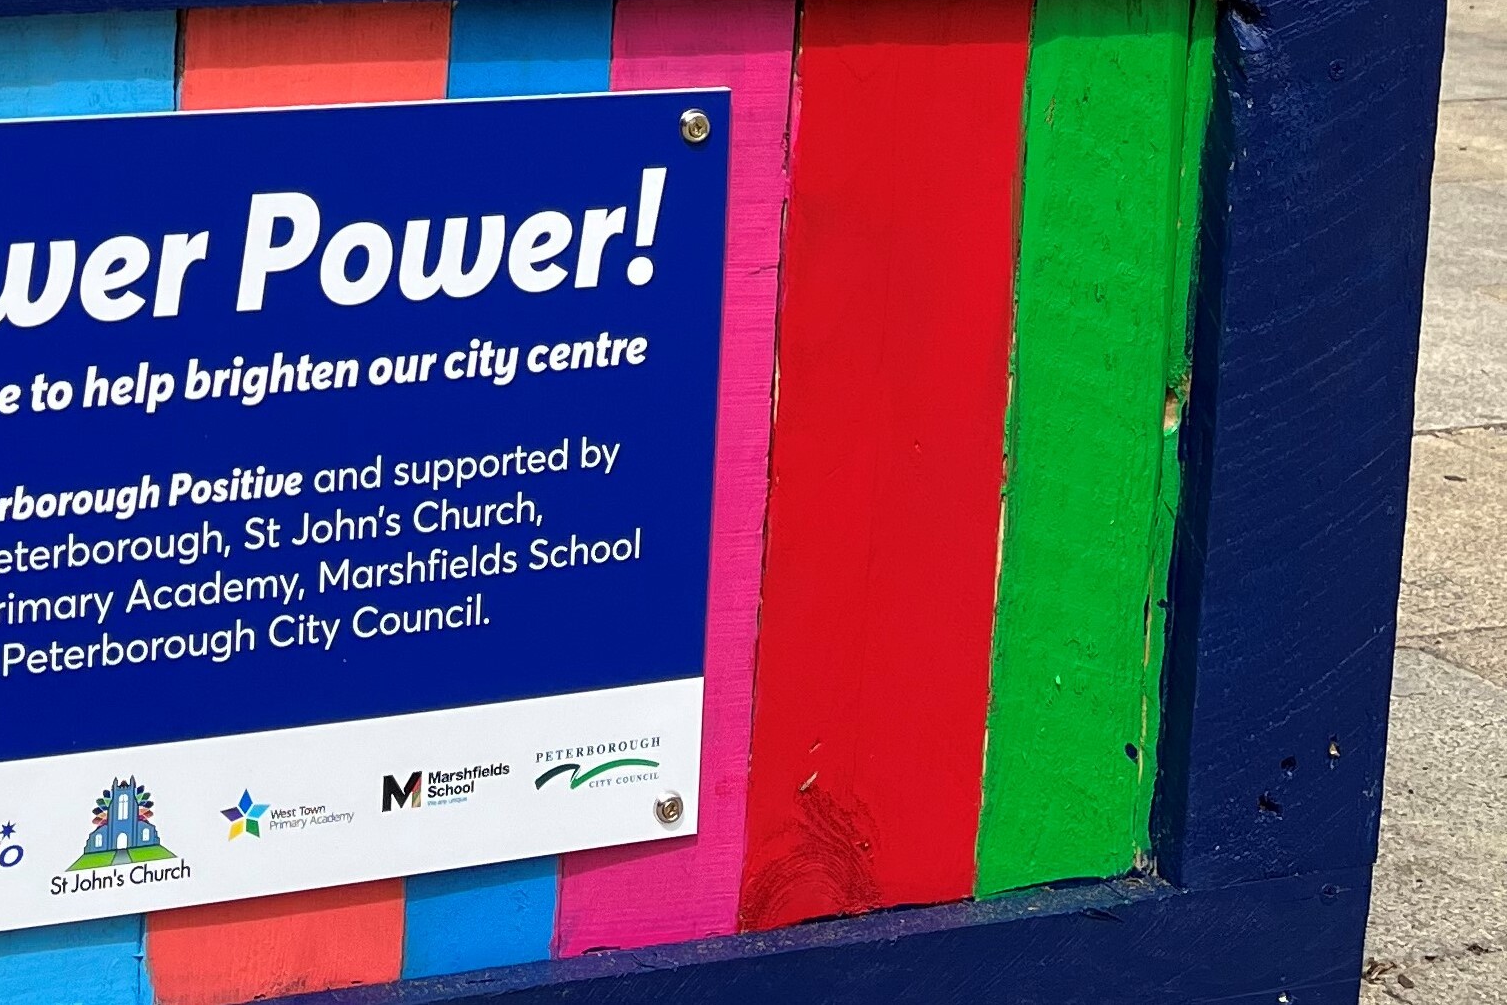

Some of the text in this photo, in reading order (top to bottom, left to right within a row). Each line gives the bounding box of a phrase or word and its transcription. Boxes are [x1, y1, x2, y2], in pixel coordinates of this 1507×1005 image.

[236, 167, 667, 311] Power!
[31, 373, 72, 411] to
[83, 362, 174, 413] help
[185, 352, 359, 405] brighten
[369, 353, 437, 385] our
[444, 339, 519, 385] city
[527, 332, 647, 372] centre
[169, 466, 302, 506] Positive
[314, 455, 381, 492] and
[394, 438, 568, 490] supported
[581, 437, 620, 474] by
[245, 517, 280, 549] St
[292, 506, 400, 545] John's
[414, 492, 542, 532] Church,
[126, 571, 304, 620] Academy,
[320, 543, 517, 593] Marshfields
[529, 528, 640, 569] School
[3, 619, 254, 676] Peterborough
[269, 615, 340, 650] City
[353, 594, 489, 637] Council.
[535, 737, 661, 763] PETERBOROUGH
[427, 780, 475, 798] School
[428, 763, 510, 785] Marshfields
[588, 772, 660, 788] CITY COUNCIL
[270, 812, 354, 830] Primary Academy
[271, 805, 326, 819] West Town
[50, 858, 191, 895] St John's Church
